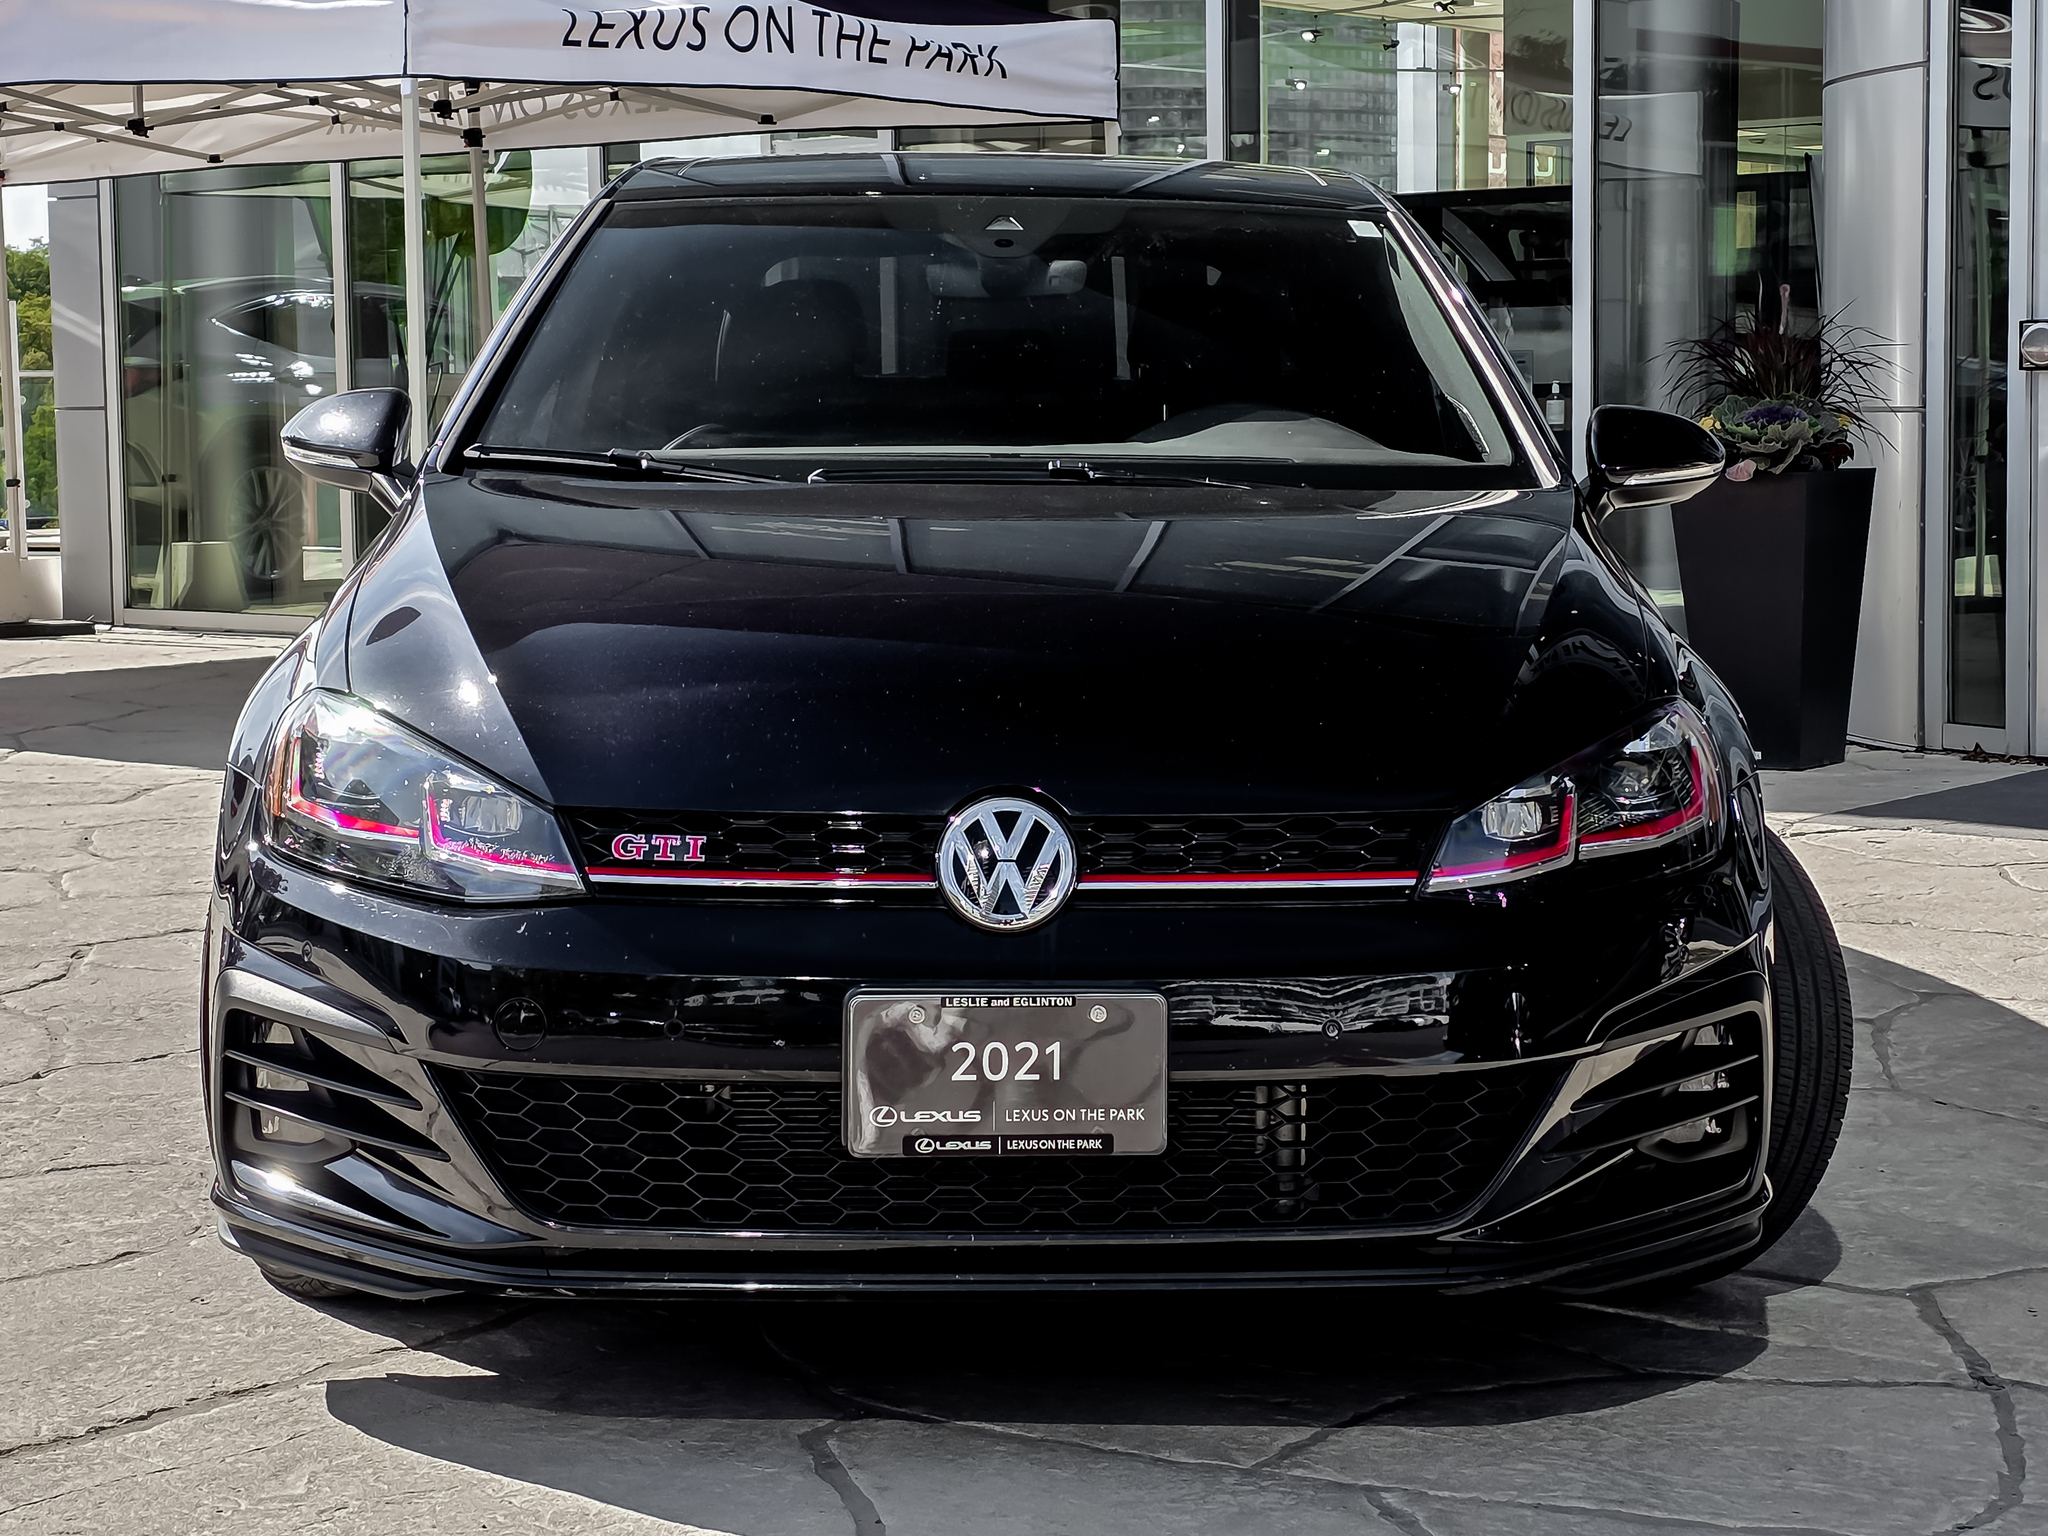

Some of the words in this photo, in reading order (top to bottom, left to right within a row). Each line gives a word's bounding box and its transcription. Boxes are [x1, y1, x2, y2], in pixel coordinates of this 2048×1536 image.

[561, 6, 711, 51] LEXUS
[724, 4, 795, 54] ON
[811, 8, 891, 65] THE
[904, 35, 1008, 80] PARK
[611, 833, 707, 862] GTI
[945, 997, 989, 1007] LESLIE
[990, 997, 1010, 1007] and
[1013, 996, 1073, 1007] EGLINTON
[951, 1041, 1062, 1081] 2021
[900, 1110, 982, 1123] LEXUS
[1005, 1109, 1050, 1122] LEXUS
[1053, 1109, 1076, 1122] ON
[1080, 1109, 1106, 1121] THE
[1109, 1108, 1146, 1121] PARK
[936, 1141, 992, 1151] LEXUS
[1006, 1139, 1038, 1150] LEXUS
[1039, 1139, 1056, 1150] ON
[1057, 1139, 1076, 1150] THE
[1077, 1138, 1103, 1150] PARK
